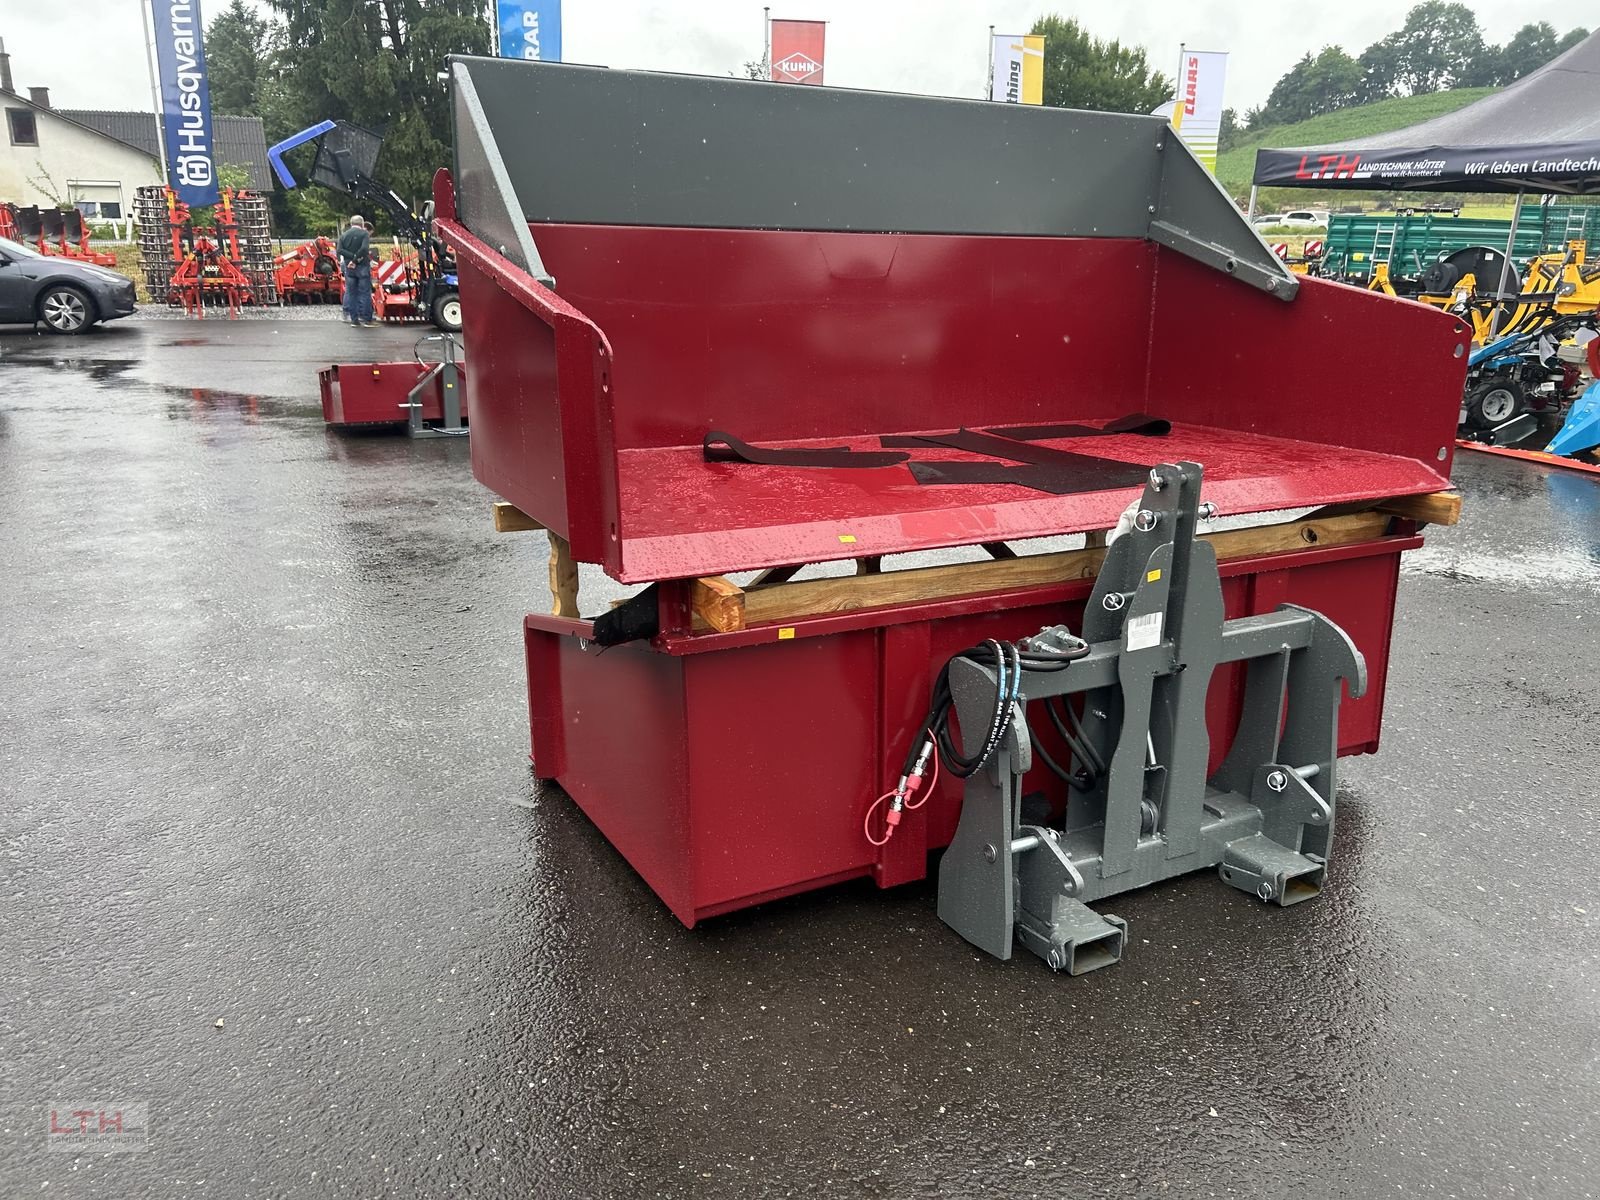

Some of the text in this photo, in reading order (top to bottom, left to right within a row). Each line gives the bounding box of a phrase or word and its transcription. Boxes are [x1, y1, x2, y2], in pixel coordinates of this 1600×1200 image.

[782, 62, 815, 72] KUHN
[170, 0, 206, 152] Husqvarn
[1185, 57, 1198, 116] CLAAS
[1296, 154, 1361, 179] LTH
[1357, 158, 1446, 171] LANDTECHNIK HÜTTER
[1464, 162, 1488, 175] Wir
[1490, 161, 1527, 174] leben
[1381, 169, 1442, 178] www.lt-huetter.at
